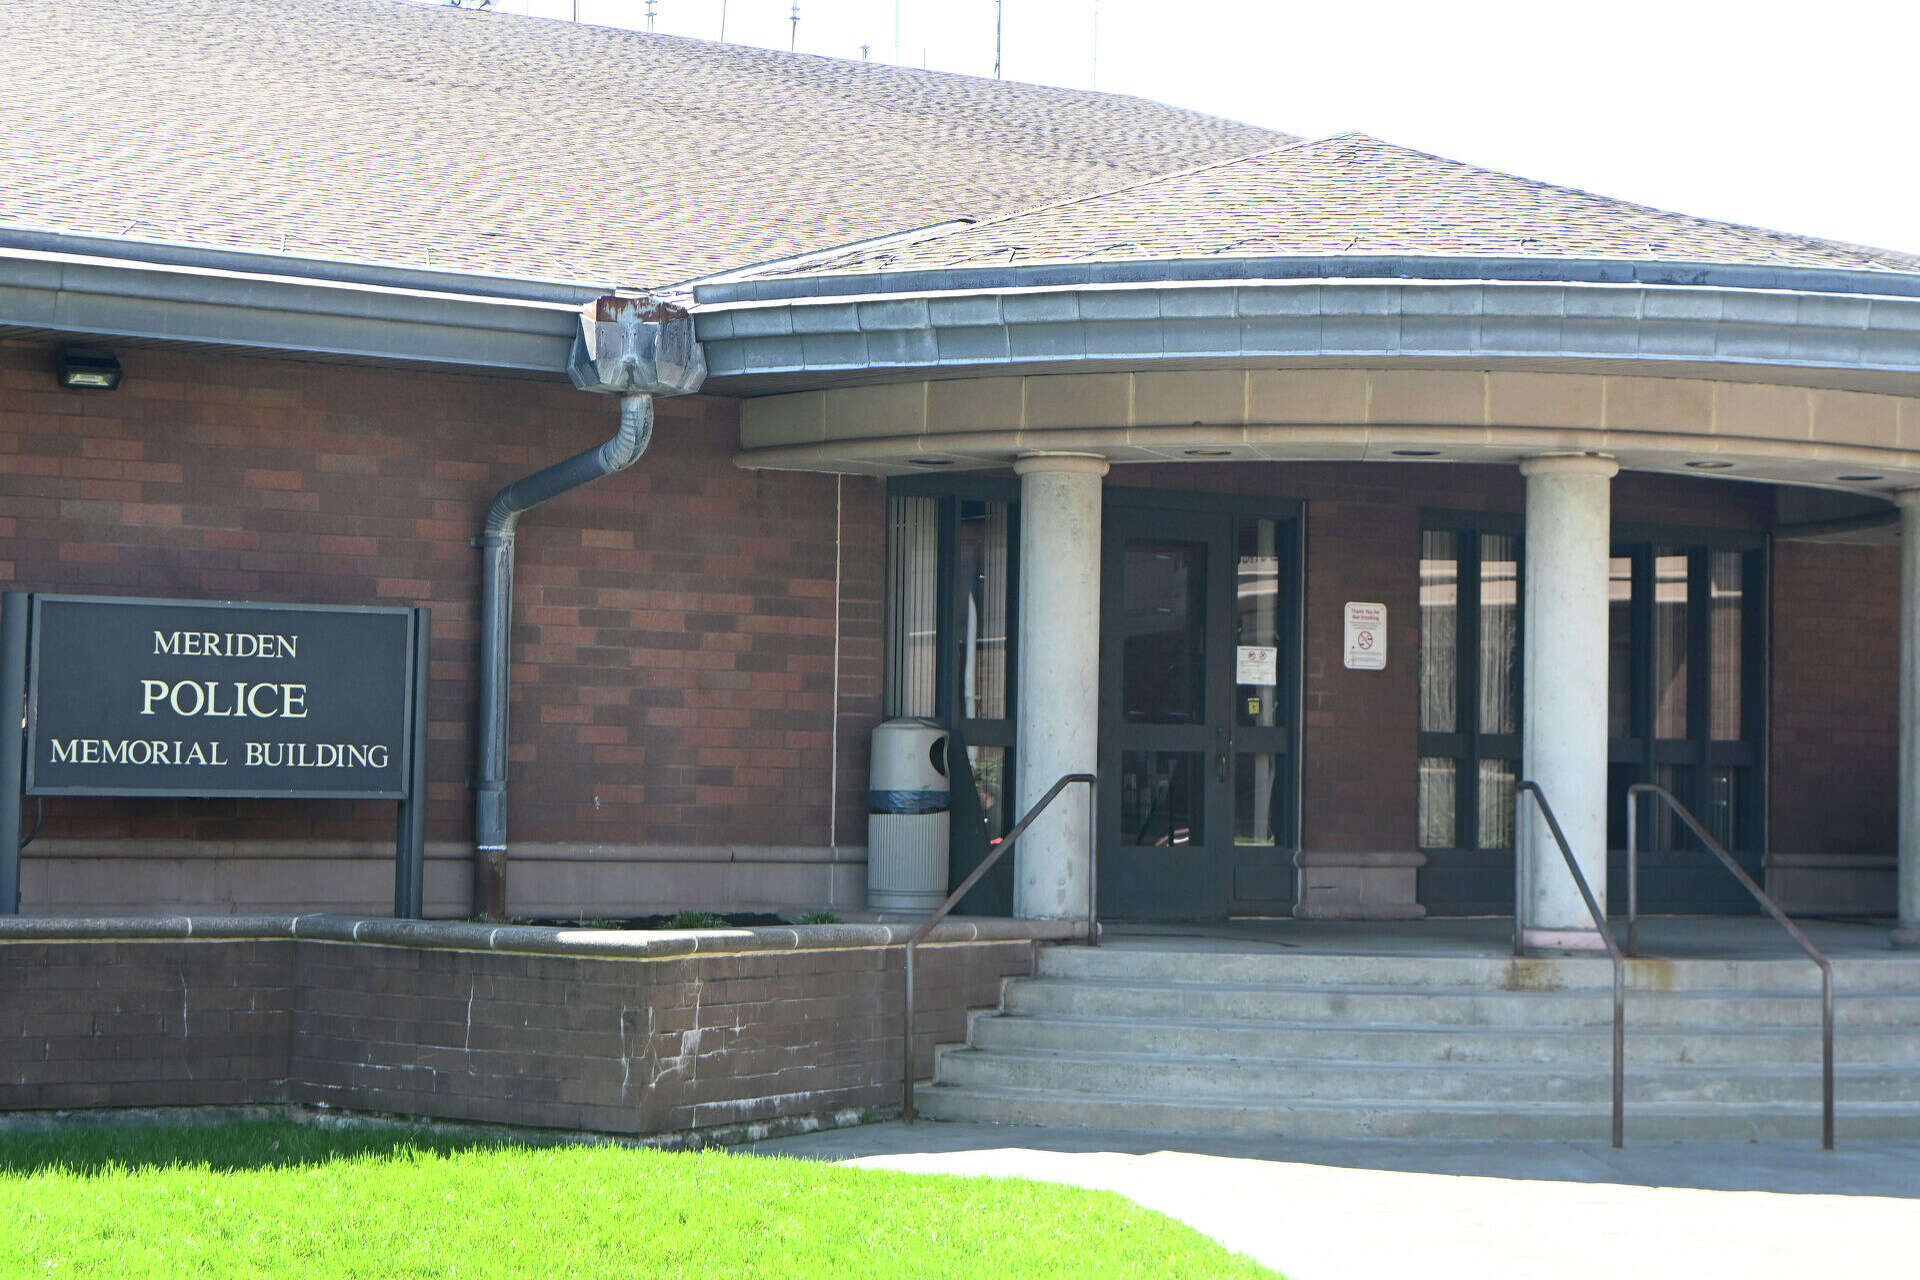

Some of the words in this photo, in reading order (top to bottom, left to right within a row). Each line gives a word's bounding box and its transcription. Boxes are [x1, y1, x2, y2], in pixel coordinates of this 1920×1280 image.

[152, 630, 299, 659] MERIDEN
[139, 679, 309, 719] POLICE
[50, 738, 228, 766] MEMORIAL
[244, 742, 389, 769] BUILDING
